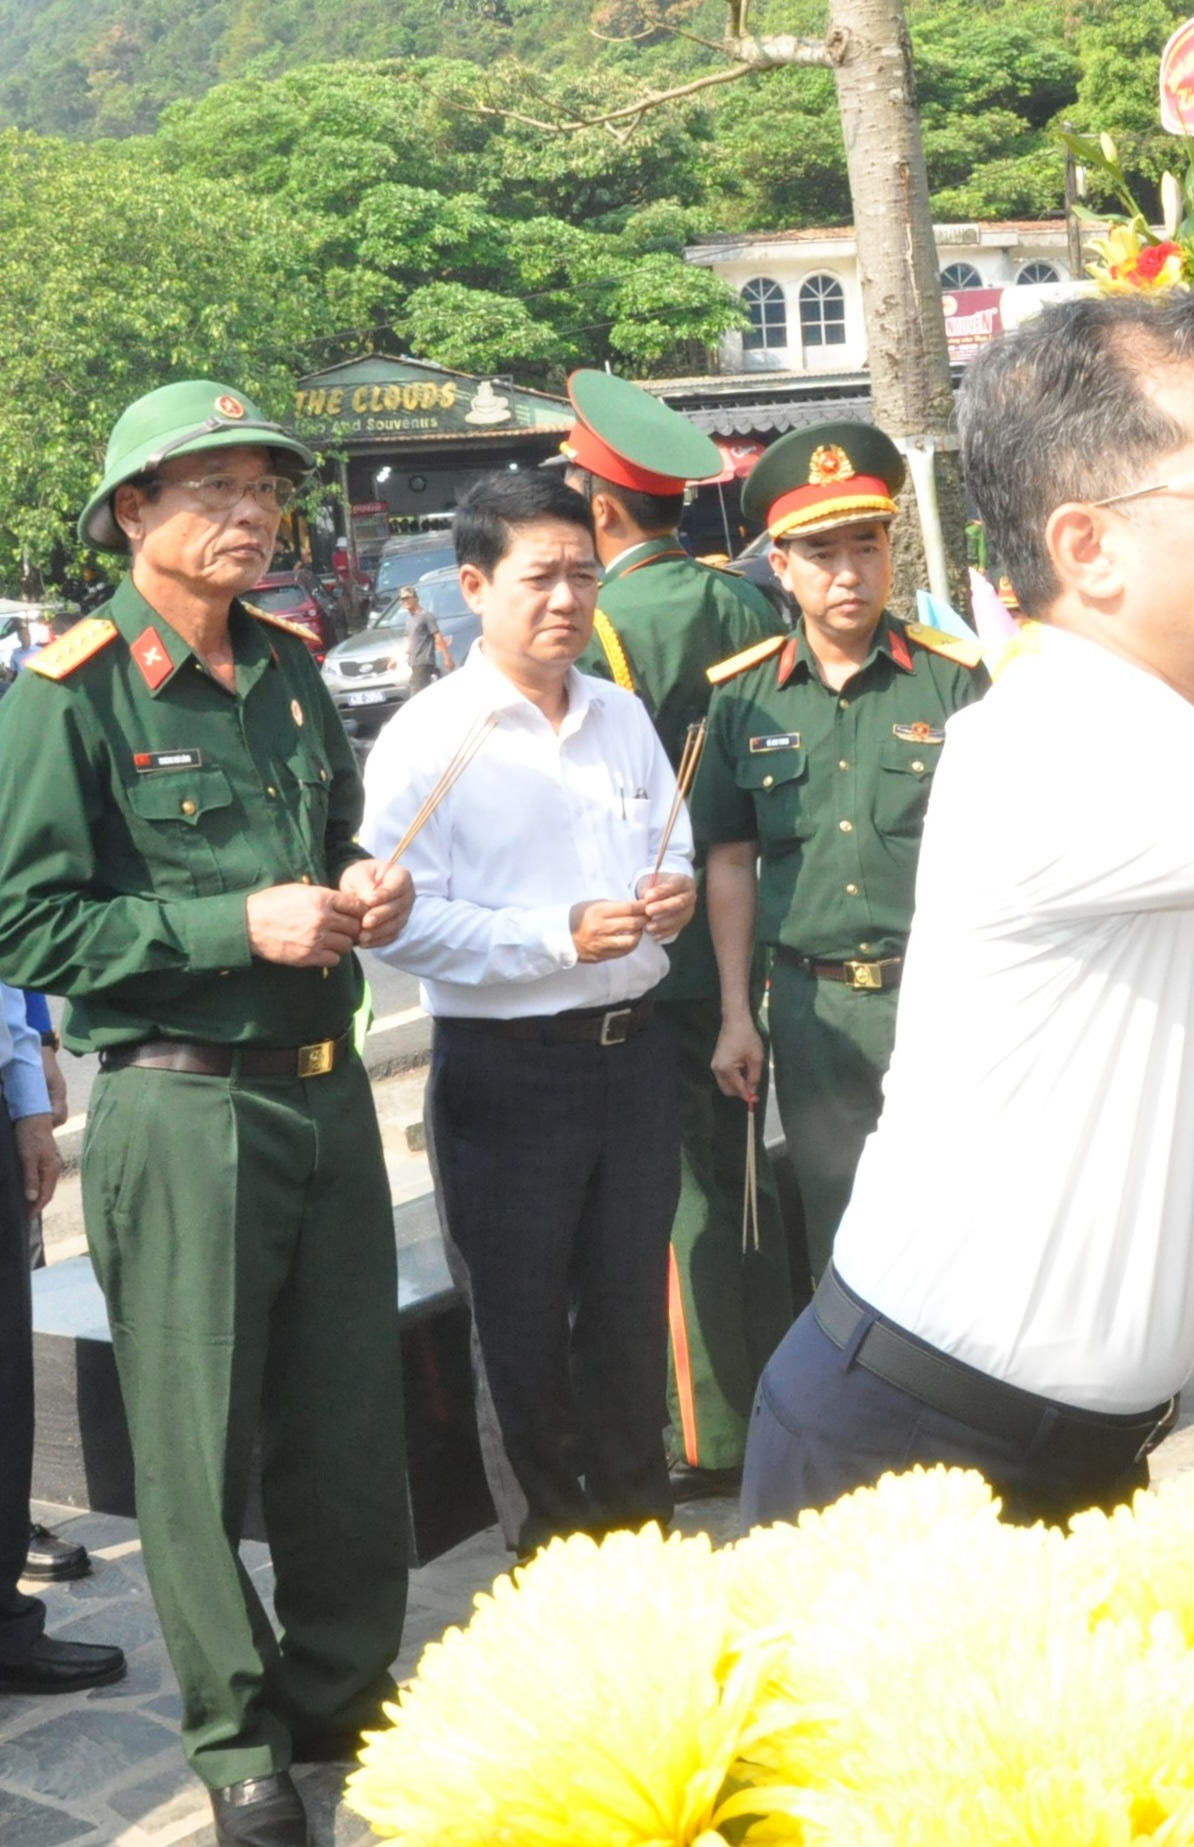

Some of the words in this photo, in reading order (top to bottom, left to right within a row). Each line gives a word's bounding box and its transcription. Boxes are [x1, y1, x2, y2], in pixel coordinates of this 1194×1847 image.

[294, 388, 345, 417] THE
[352, 381, 457, 413] CLOUDS
[331, 417, 361, 433] Ad
[366, 416, 438, 431] Souvenirs
